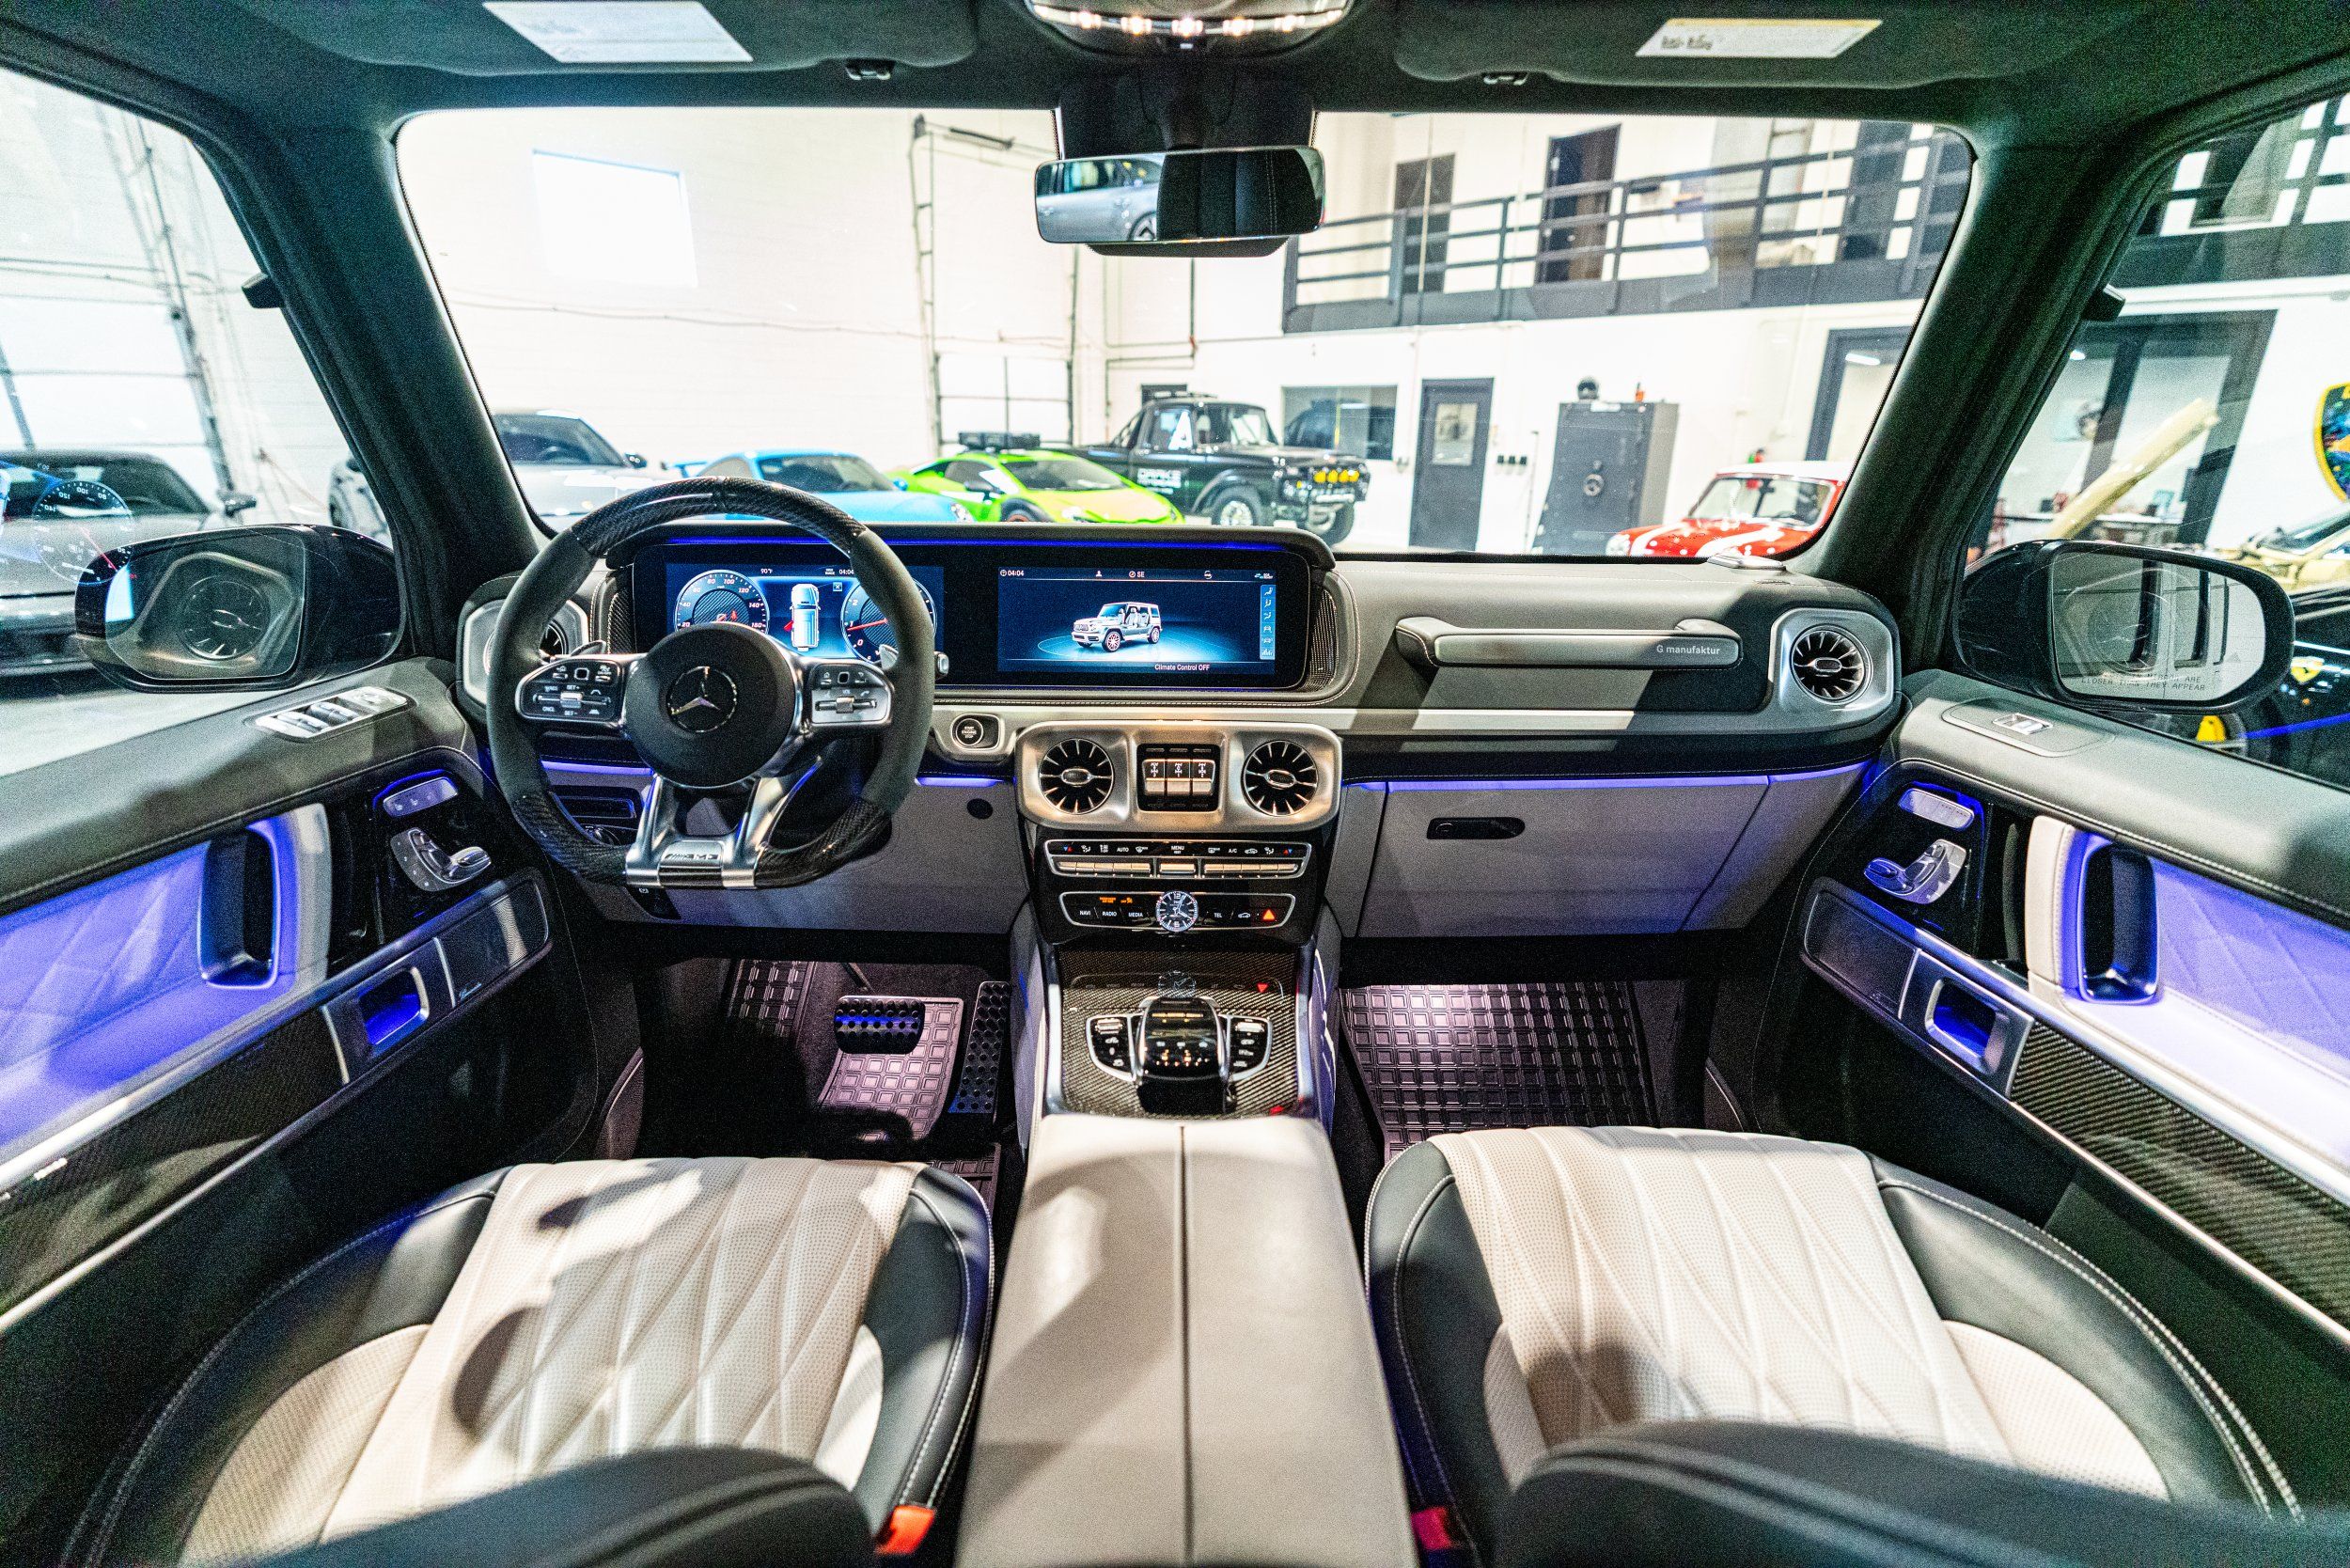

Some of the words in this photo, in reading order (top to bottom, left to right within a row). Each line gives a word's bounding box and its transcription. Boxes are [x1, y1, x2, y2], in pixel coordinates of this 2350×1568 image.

[1656, 644, 1664, 653] G
[1666, 645, 1720, 655] manufaktur
[2081, 677, 2113, 685] CLOSER
